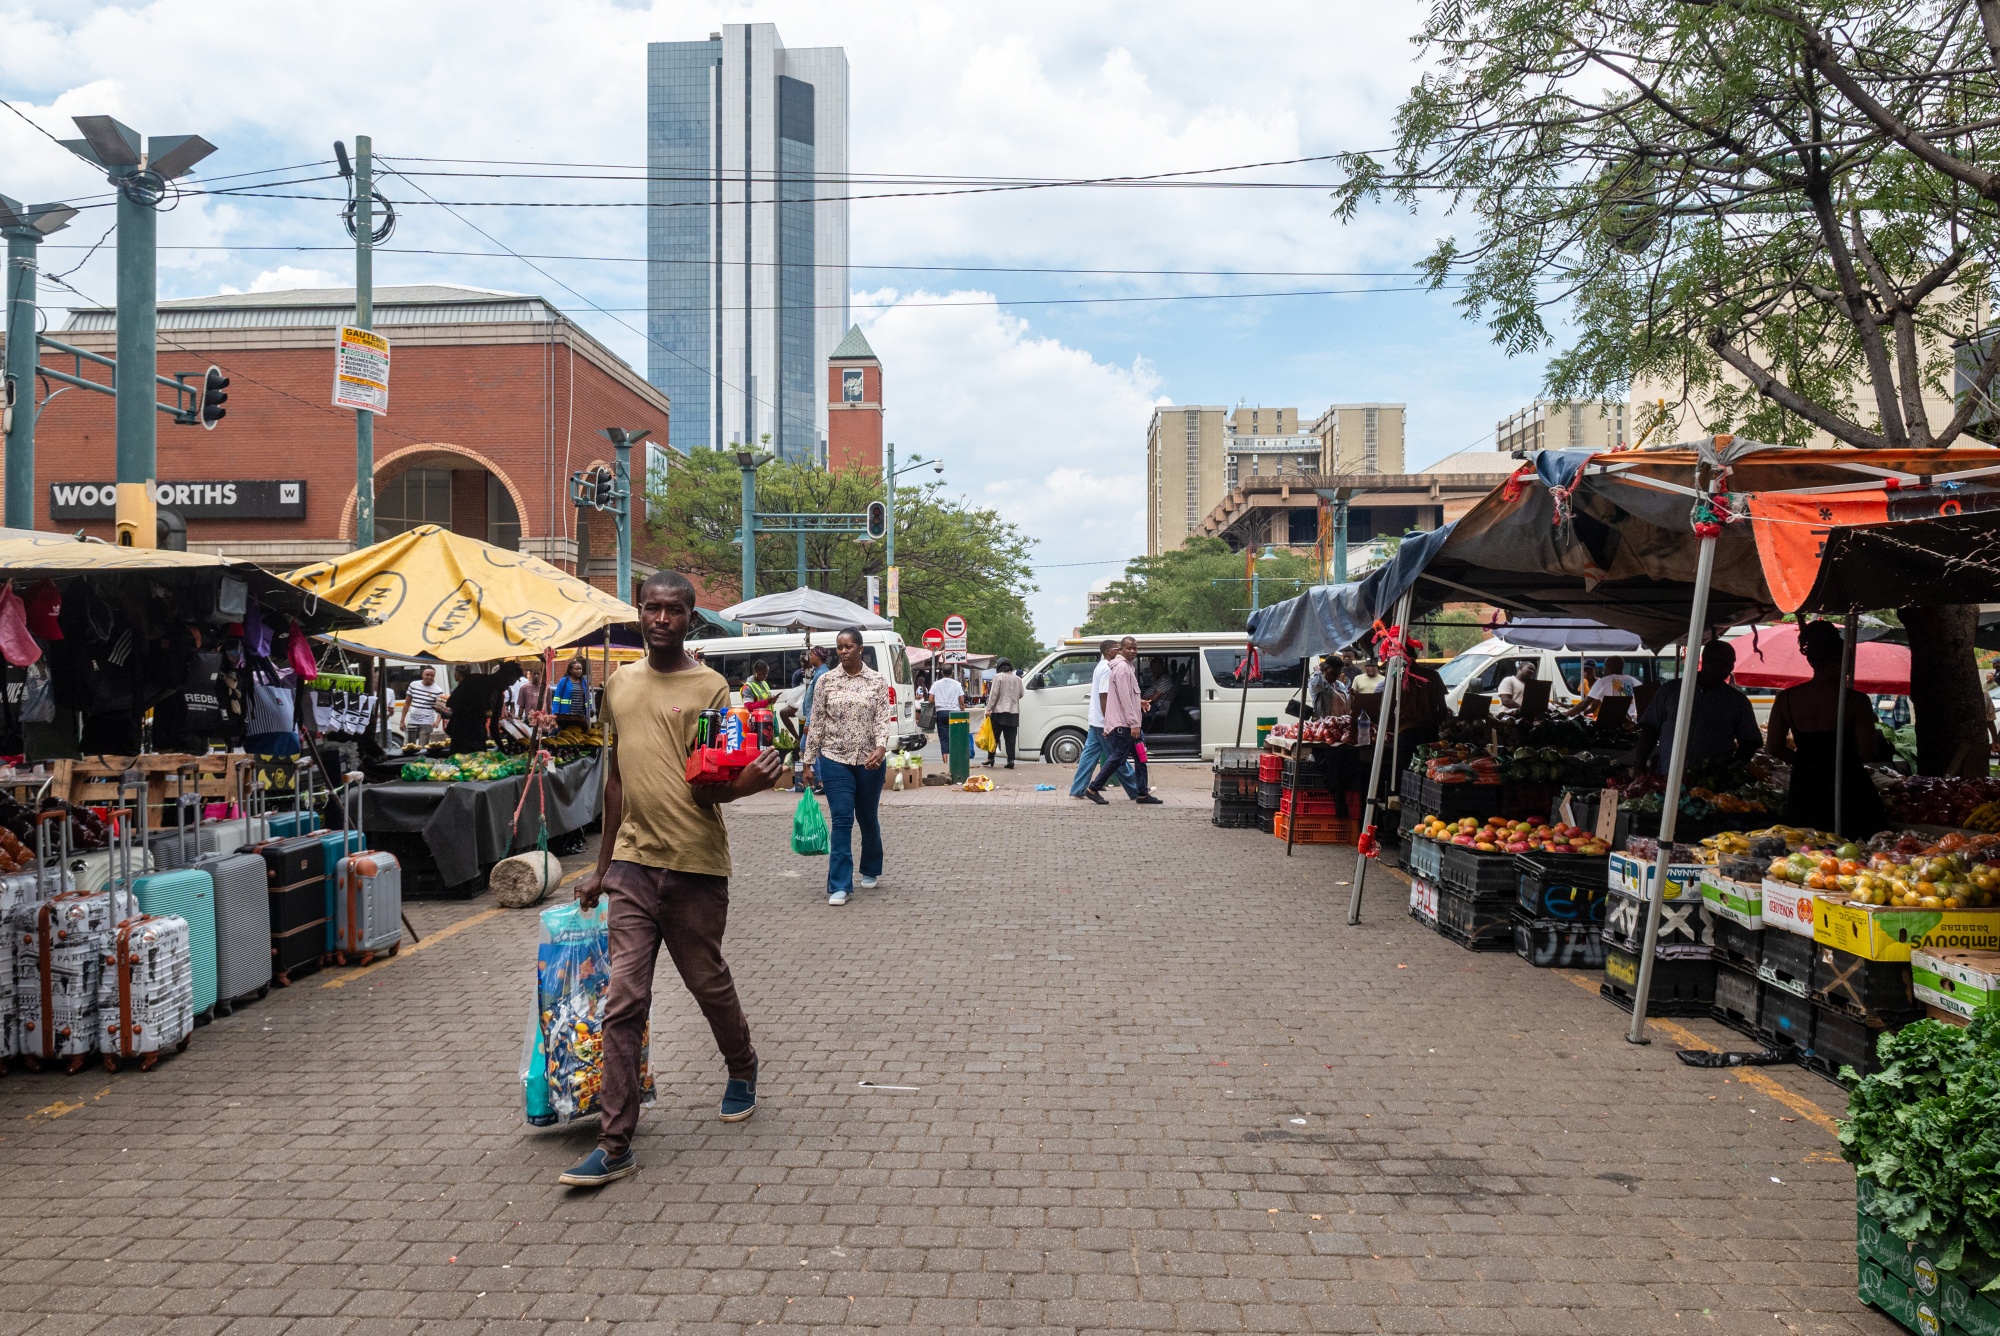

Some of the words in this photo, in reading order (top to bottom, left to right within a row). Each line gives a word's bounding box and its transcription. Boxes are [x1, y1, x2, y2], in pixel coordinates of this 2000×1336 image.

[345, 328, 386, 345] GAUTENG
[345, 335, 361, 344] CITY
[362, 339, 385, 351] COLLEGE
[345, 356, 380, 367] ENGINEERING
[345, 360, 369, 369] BUSINESS
[53, 484, 237, 506] WOOORTHS
[284, 489, 296, 498] W
[438, 598, 472, 633] MTN
[726, 714, 739, 754] FANTA
[1941, 924, 1989, 933] bananas
